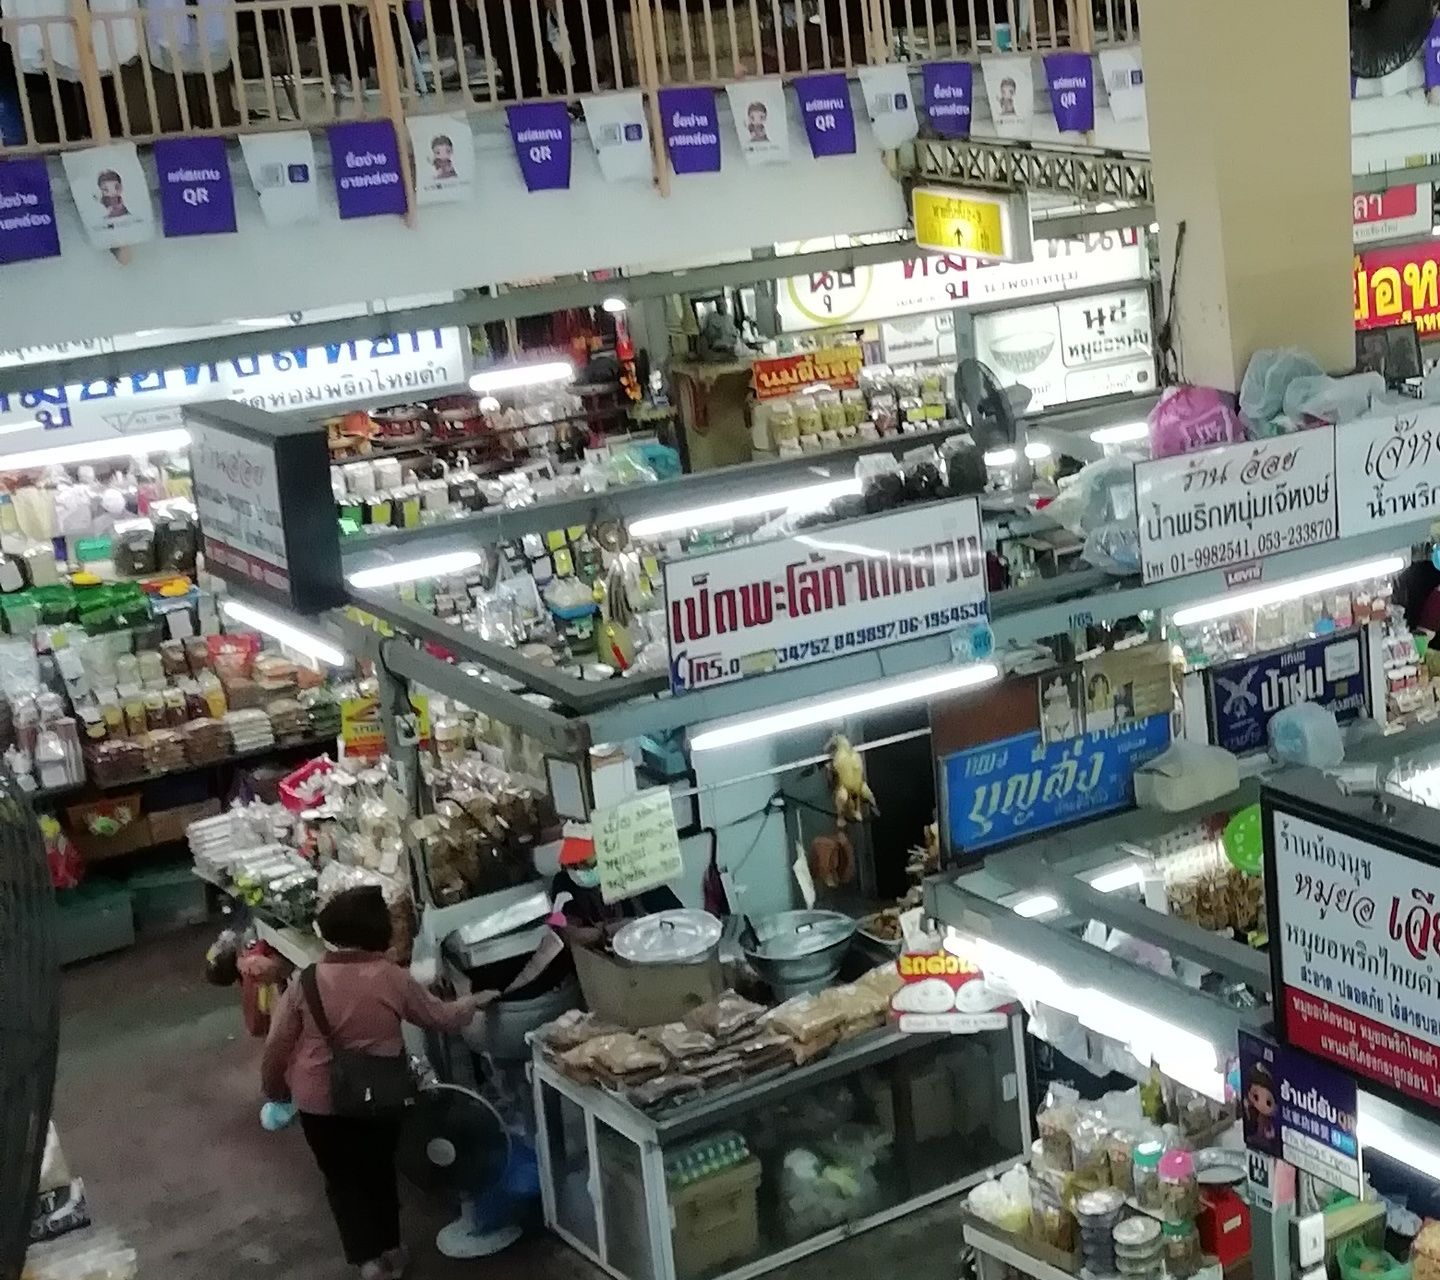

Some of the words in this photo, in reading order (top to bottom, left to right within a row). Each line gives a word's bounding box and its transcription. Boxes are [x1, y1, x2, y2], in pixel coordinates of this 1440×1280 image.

[815, 115, 837, 132] QR
[529, 145, 553, 164] QR
[183, 189, 210, 207] QR
[1182, 459, 1229, 493] ร้าน
[1240, 443, 1301, 485] อ้อย
[671, 534, 981, 645] เป็ดพะโล้กาดหลวง
[1280, 820, 1372, 887] ร้านน้องนุช
[1295, 872, 1377, 929] หมูยอ
